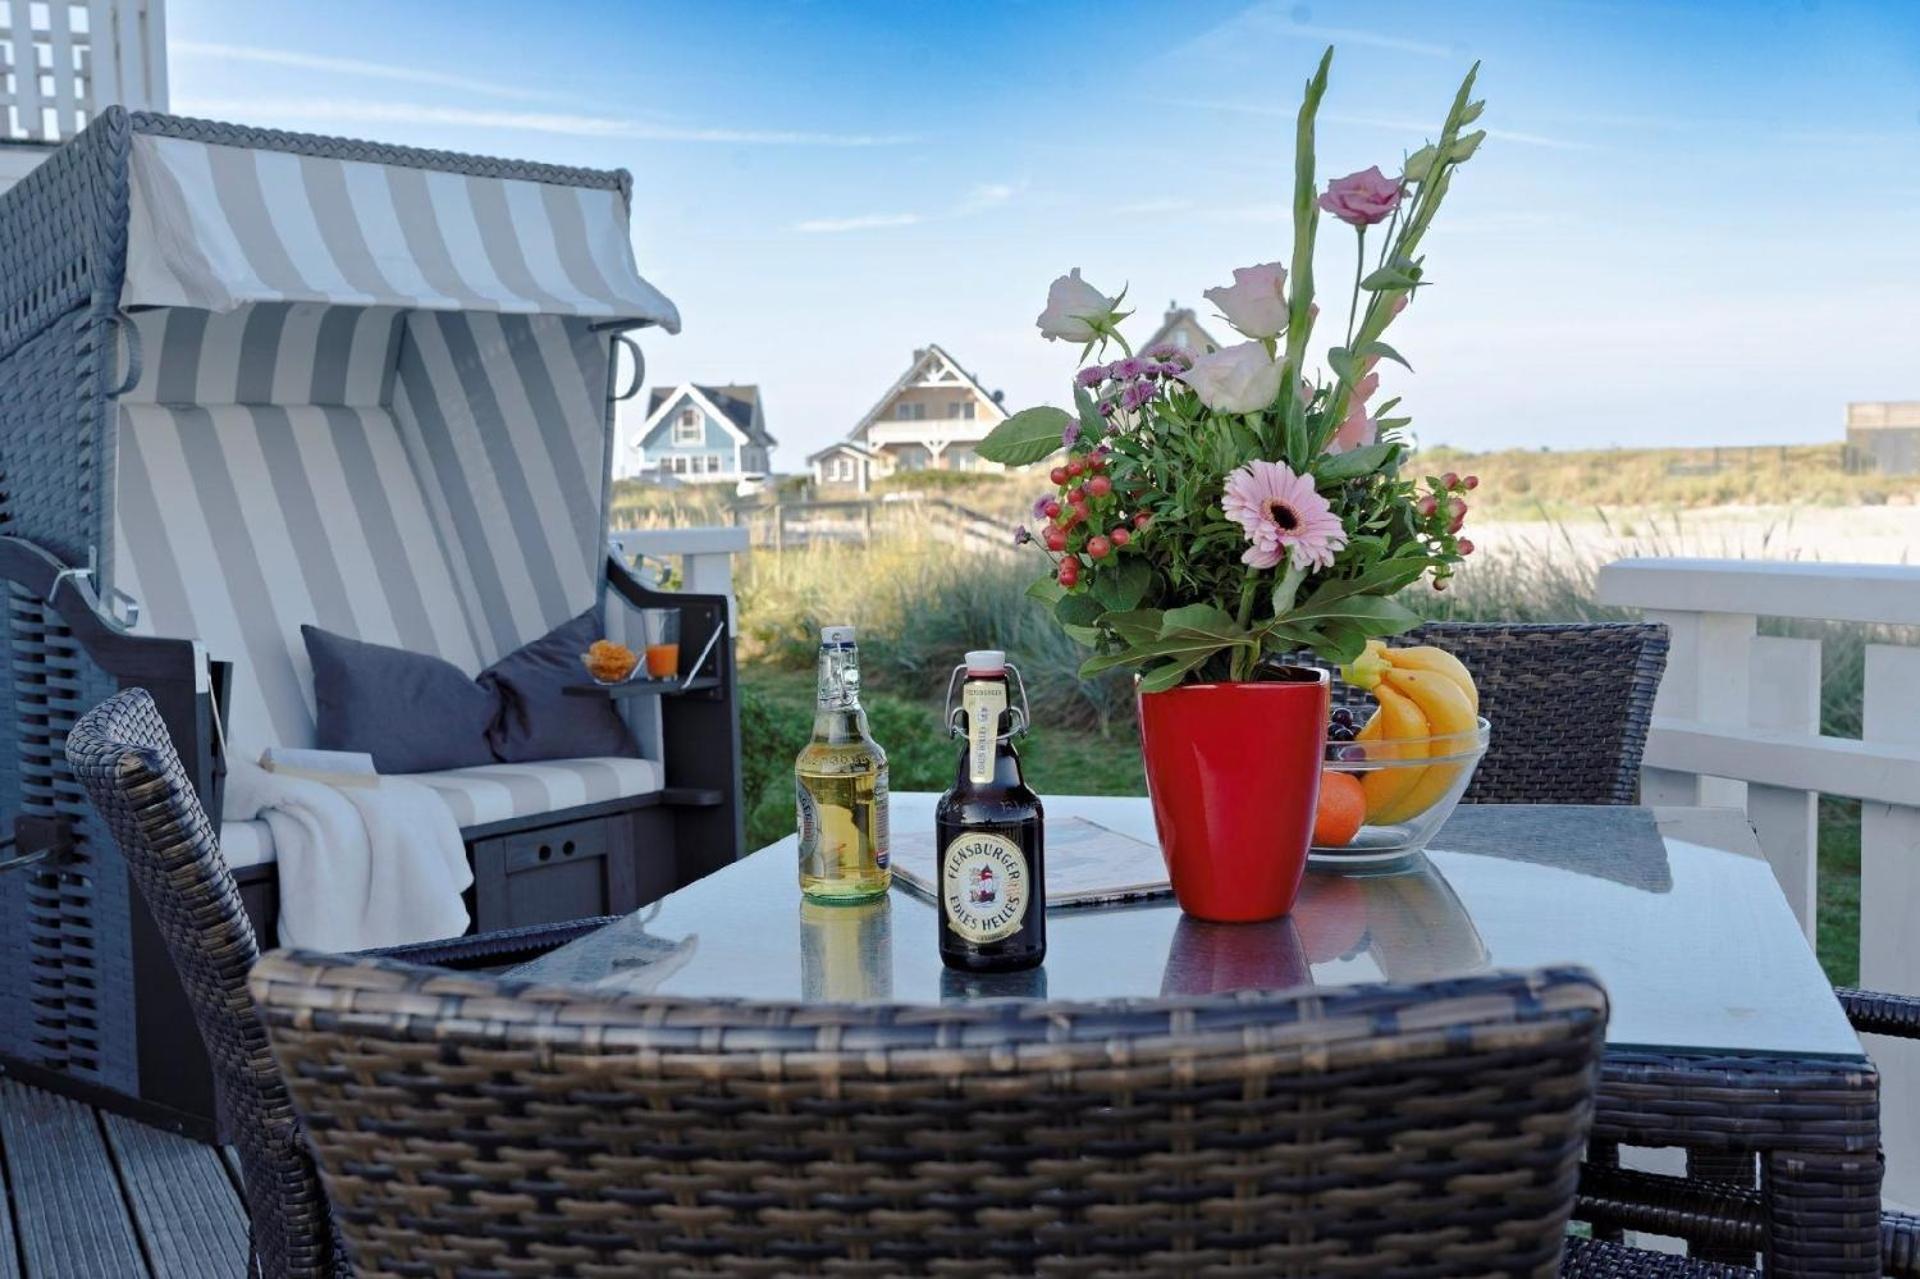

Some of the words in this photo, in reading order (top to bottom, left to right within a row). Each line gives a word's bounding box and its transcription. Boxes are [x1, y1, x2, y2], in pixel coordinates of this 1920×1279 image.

[949, 843, 1021, 880] FLENSBURGER
[950, 895, 978, 930] EDLES
[982, 896, 1020, 931] HELLES
